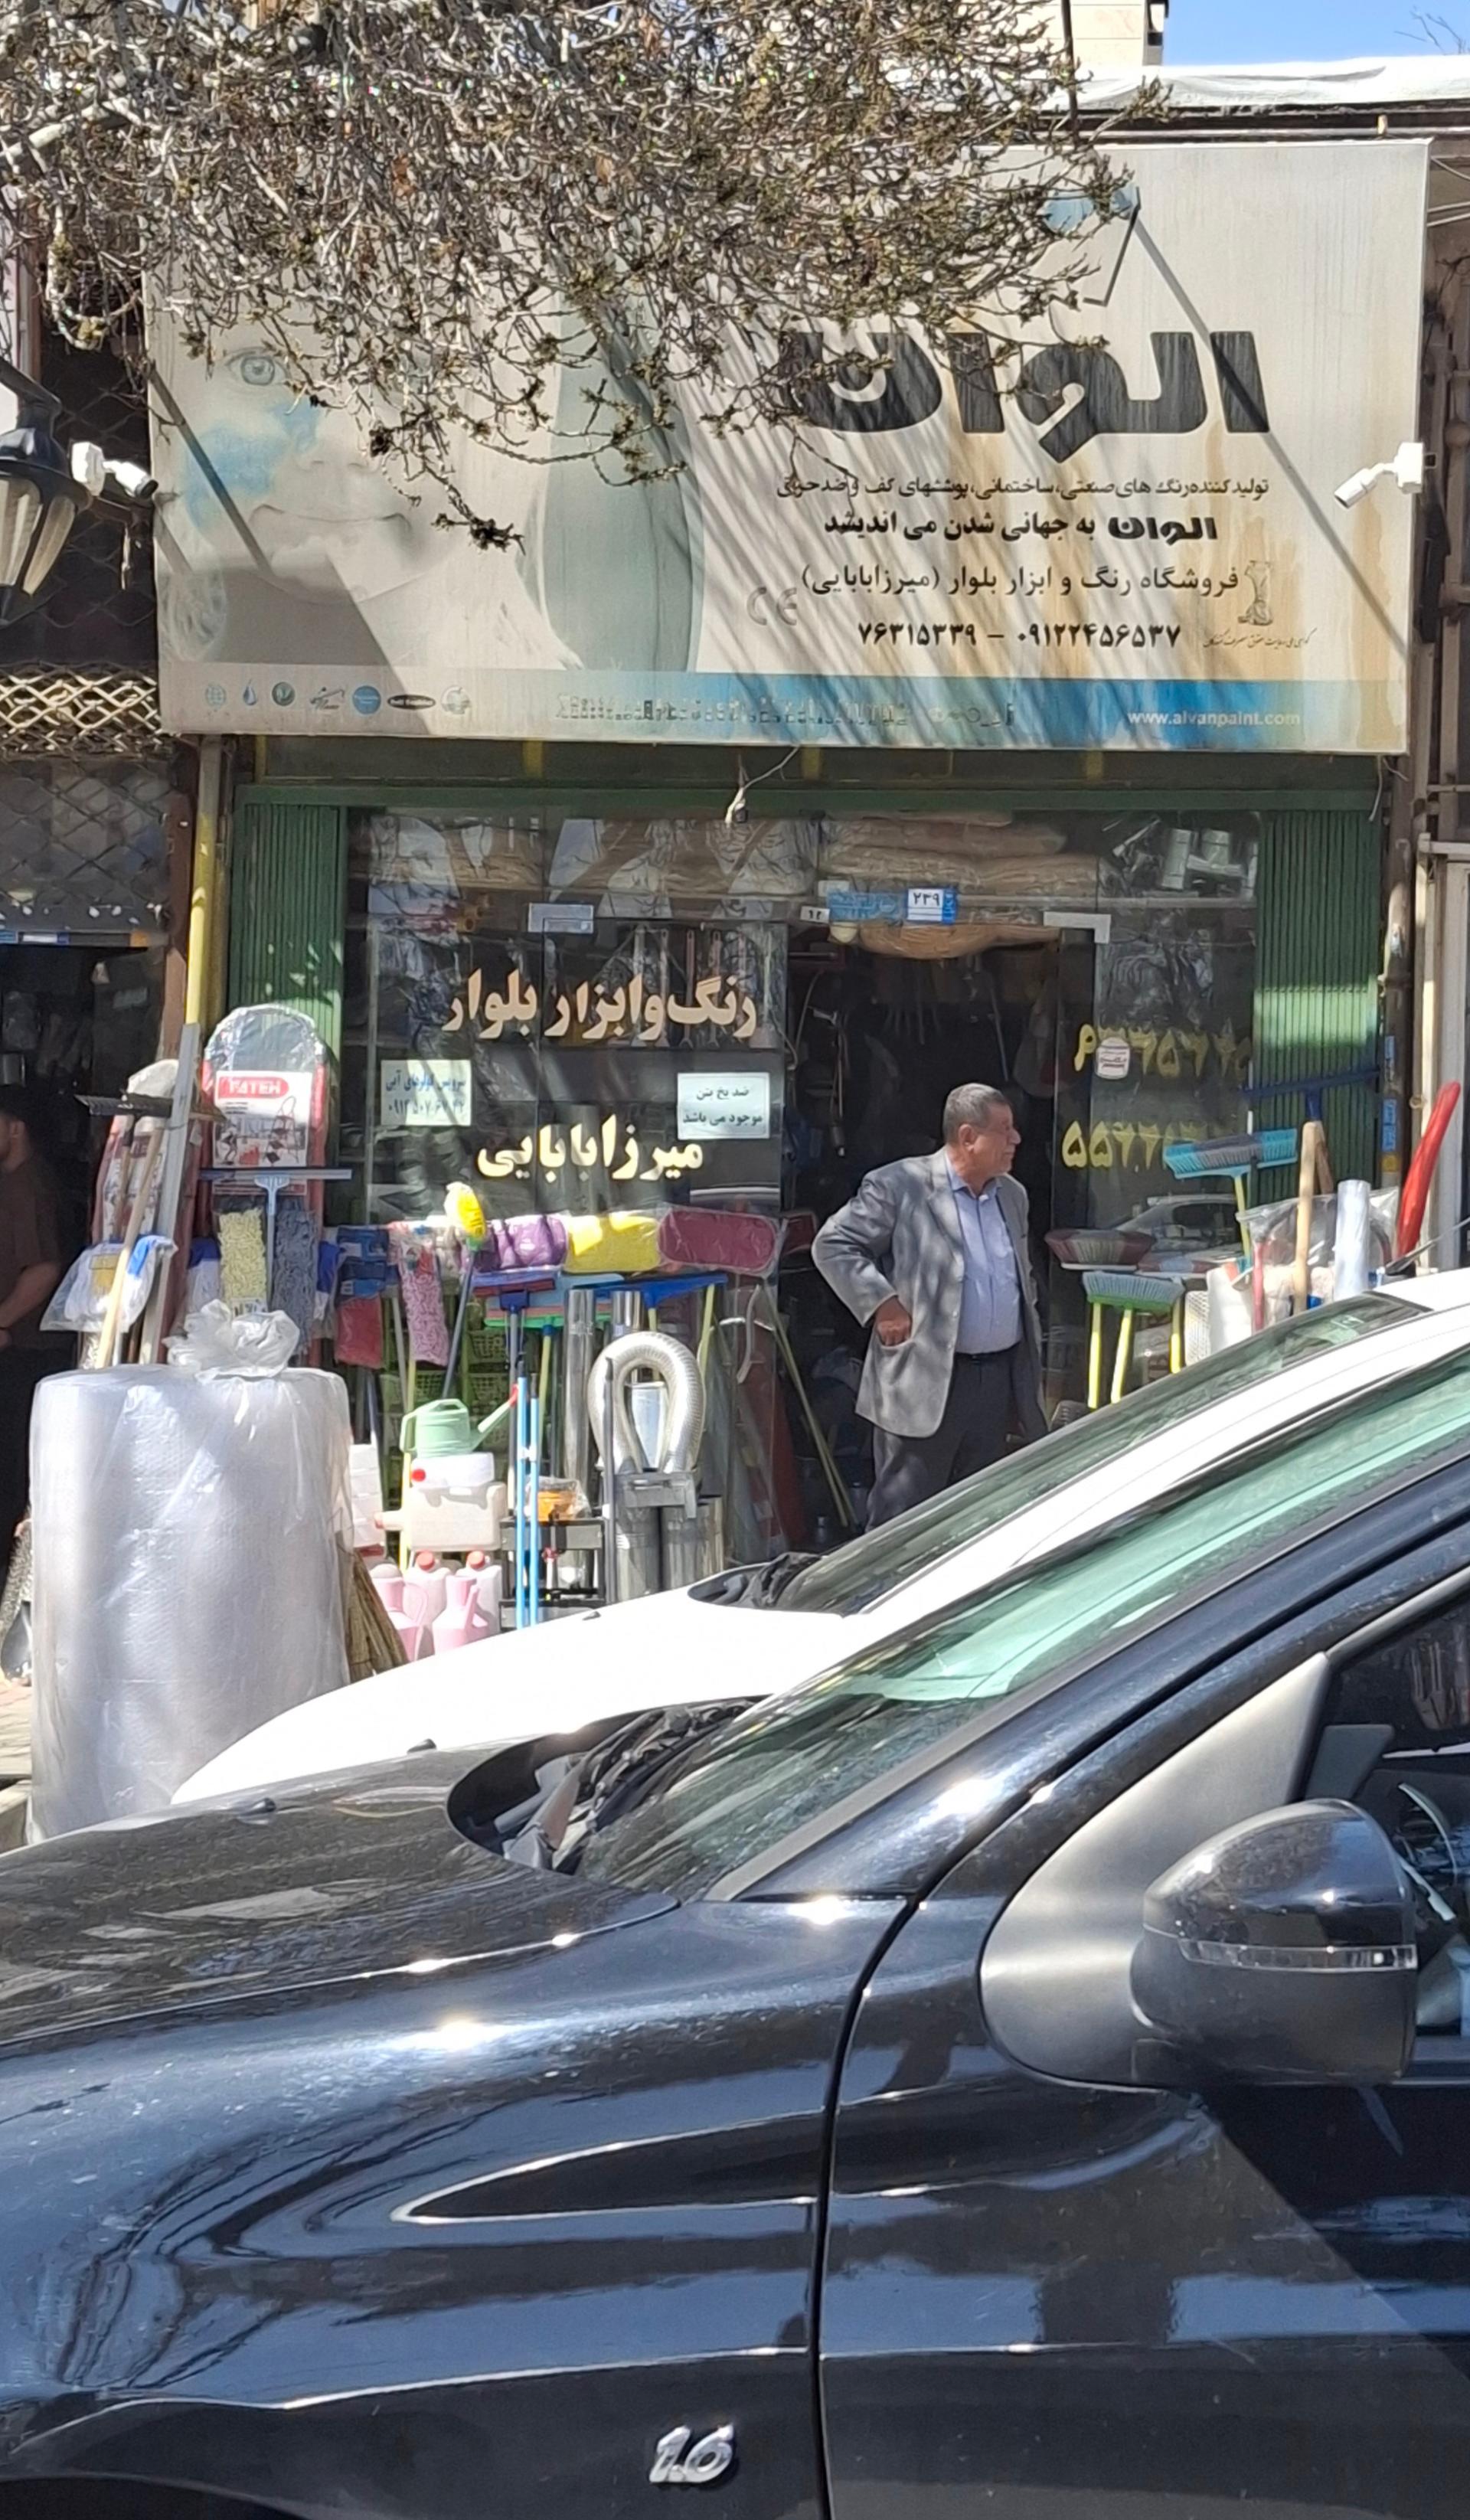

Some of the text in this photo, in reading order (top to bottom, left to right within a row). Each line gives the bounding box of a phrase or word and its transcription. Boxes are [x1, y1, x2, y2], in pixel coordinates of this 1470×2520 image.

[778, 331, 1270, 464] الوان
[864, 478, 895, 494] کف
[1116, 478, 1151, 498] های
[1155, 478, 1190, 498] رنگ
[1232, 477, 1269, 501] تولید
[824, 511, 1218, 546] الوان به جهانی شدن می اندیشد
[948, 565, 997, 596] بلوار
[1005, 566, 1052, 596] ابزار
[1060, 576, 1072, 596] و
[1080, 566, 1130, 596] رنگ
[1140, 567, 1239, 598] فروشگاه
[858, 622, 977, 646] ۷۶۳۱۵۳۳۹
[1017, 623, 1181, 648] ۰۹۱۲۲۴۵۶۵۳۷
[1129, 709, 1301, 727] www.alvanpaint.com
[441, 967, 537, 1038] بلوار
[544, 974, 644, 1040] ابزار
[667, 976, 757, 1038] رنگ
[229, 1079, 280, 1096] FATEH
[682, 1111, 763, 1126] موجود می باشد
[649, 2424, 734, 2482] 1.6
